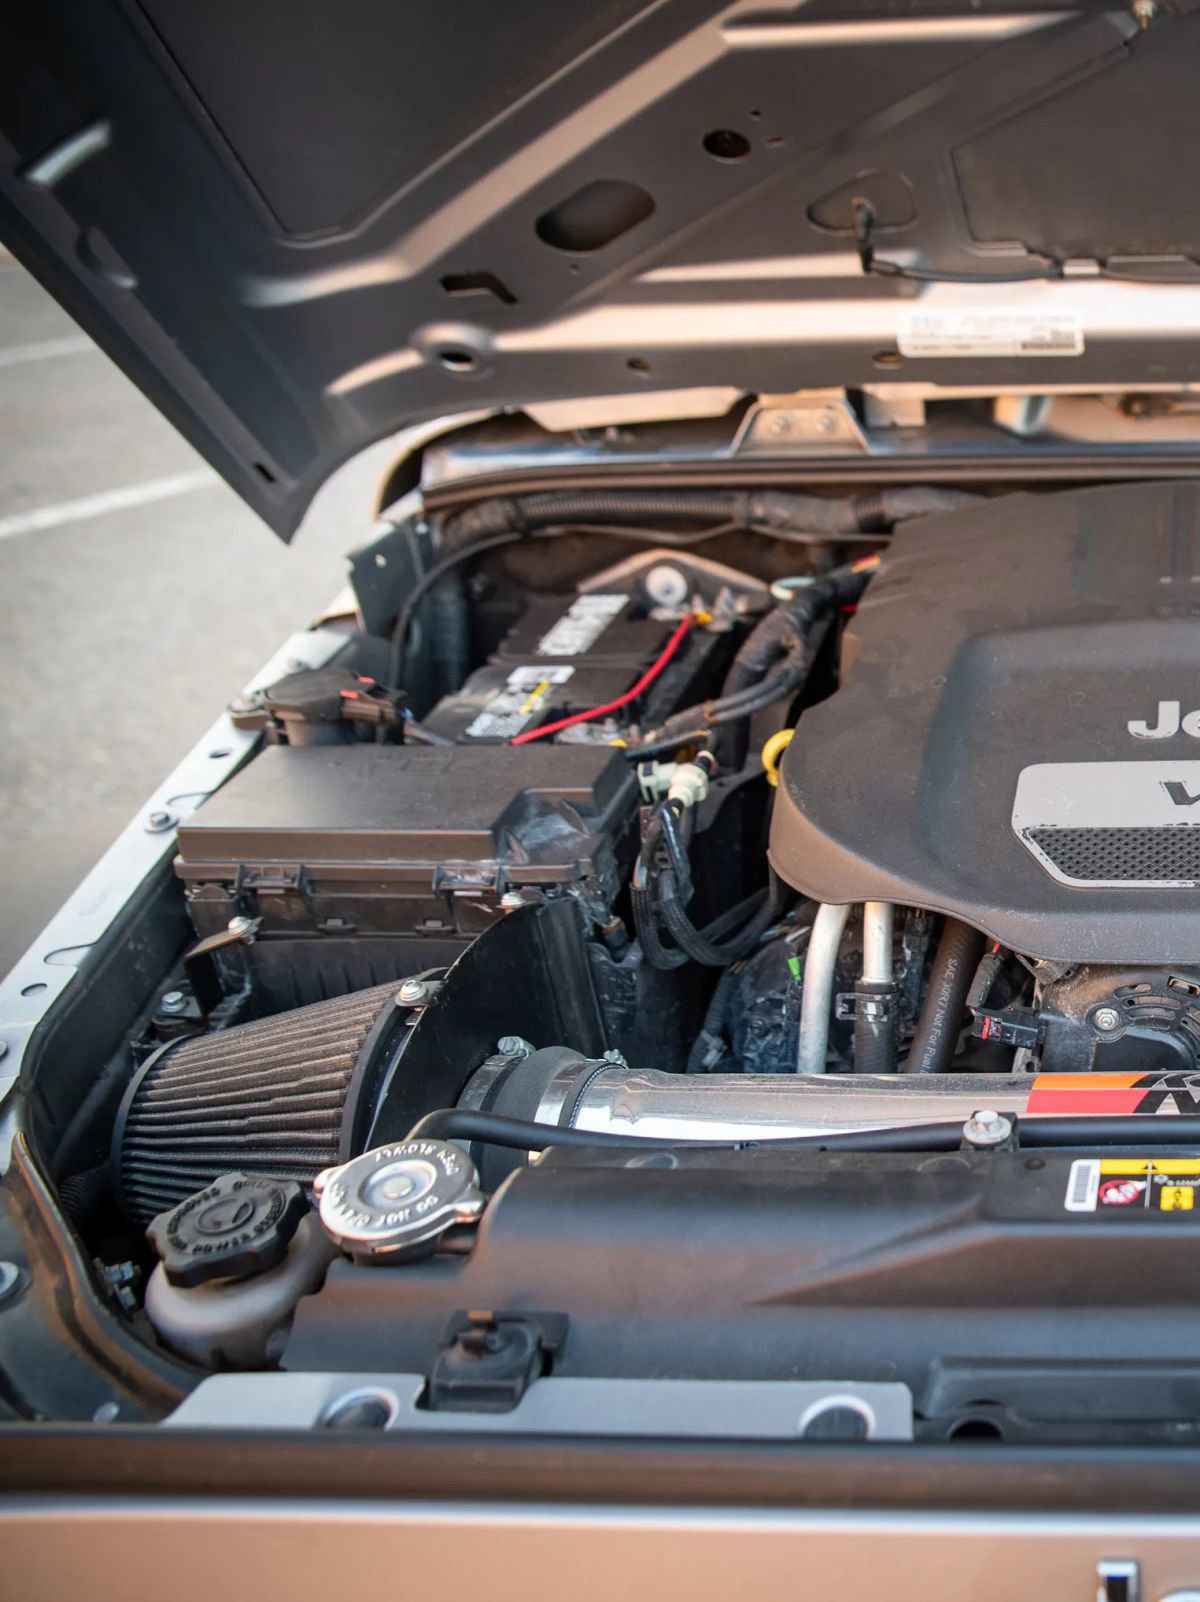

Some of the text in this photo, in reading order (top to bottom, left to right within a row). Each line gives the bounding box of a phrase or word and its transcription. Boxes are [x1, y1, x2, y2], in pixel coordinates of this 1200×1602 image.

[945, 959, 958, 979] SAE
[932, 1010, 945, 1026] Not
[929, 1027, 941, 1045] For
[922, 1046, 936, 1069] Fuel
[375, 1142, 436, 1162] SLOWLY
[375, 1208, 412, 1226] NOT
